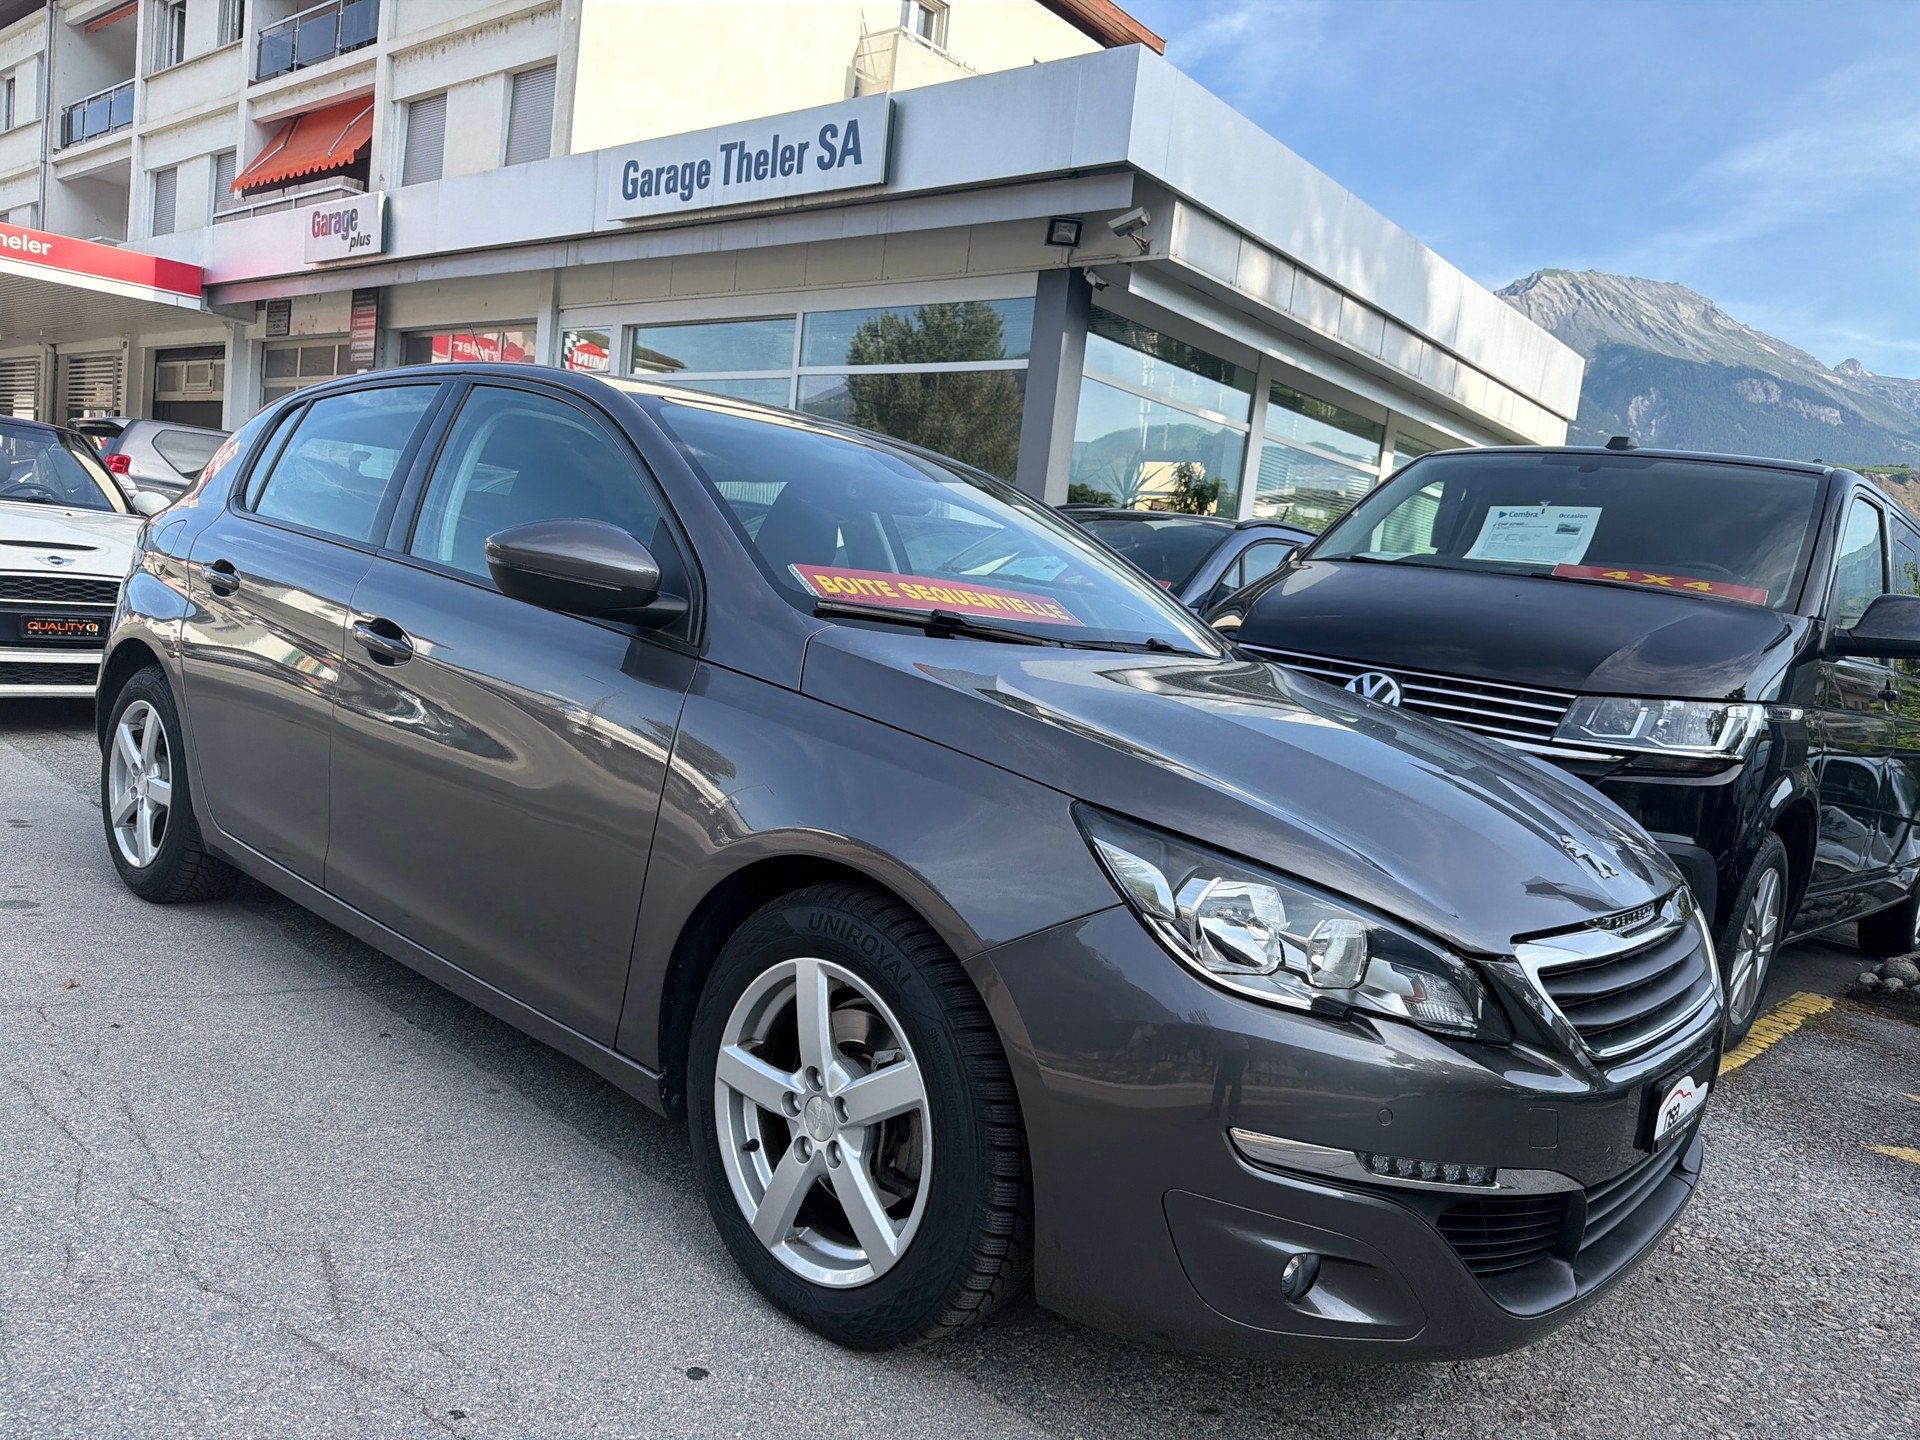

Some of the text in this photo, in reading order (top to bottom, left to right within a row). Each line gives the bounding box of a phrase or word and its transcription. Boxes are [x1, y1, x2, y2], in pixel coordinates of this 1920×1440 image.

[621, 118, 862, 202] Garage Theler SA
[311, 208, 359, 241] Garage
[348, 231, 371, 253] plus
[813, 574, 901, 599] BOITE
[897, 582, 1072, 622] SEQUENTIELLE
[808, 911, 912, 990] UNIROYAL
